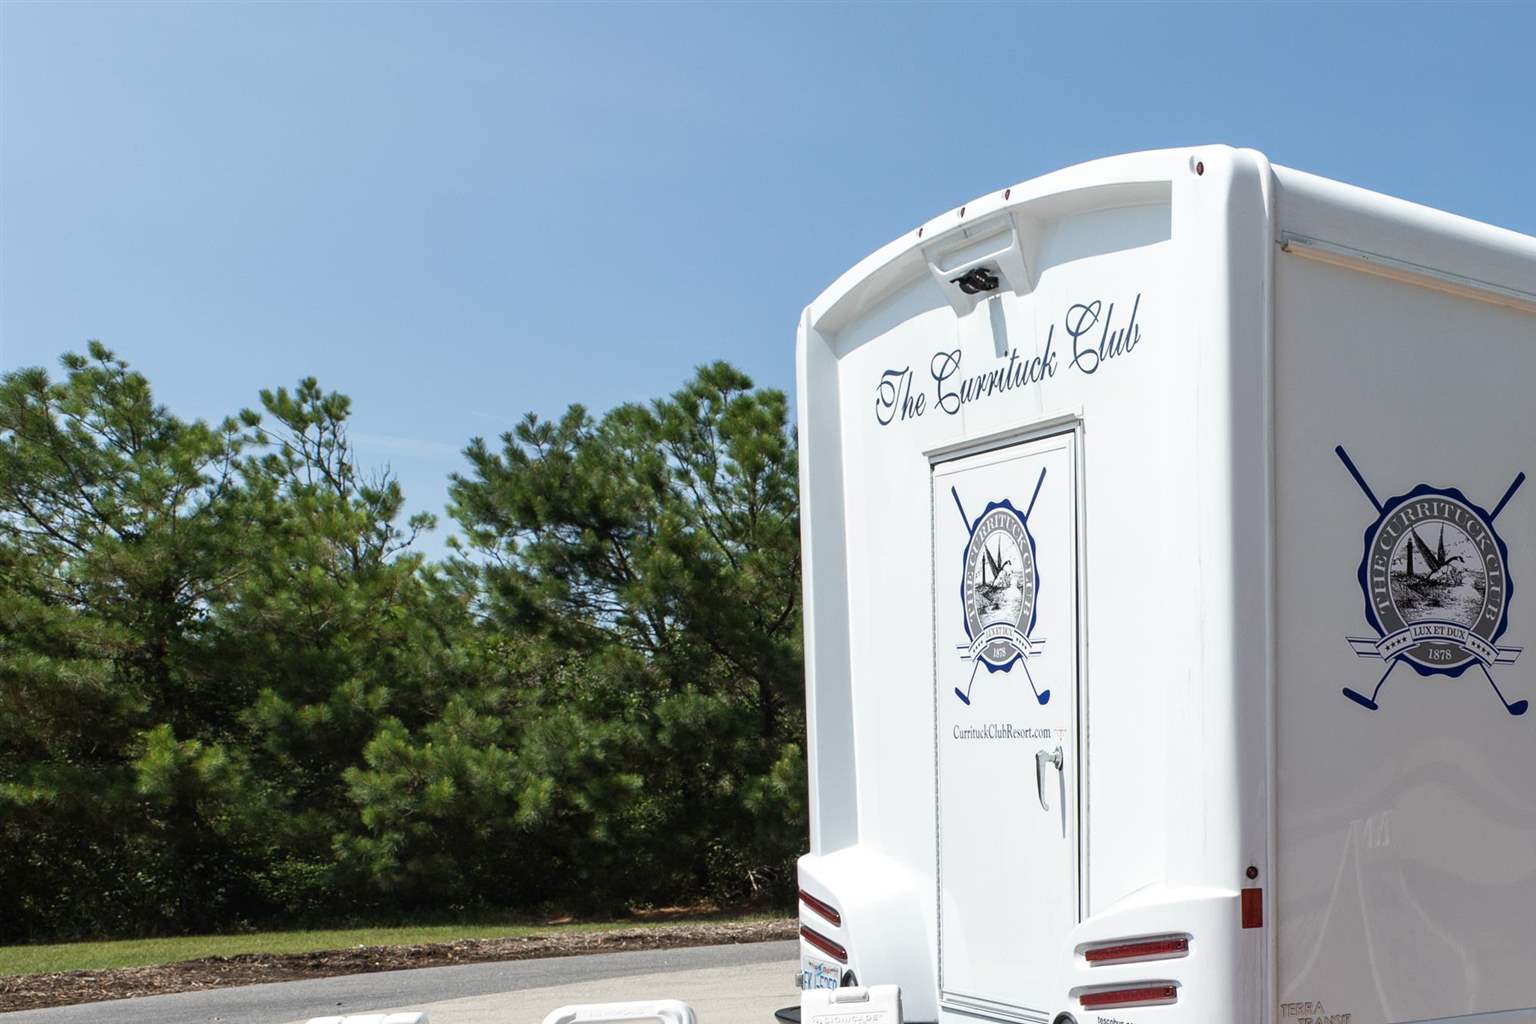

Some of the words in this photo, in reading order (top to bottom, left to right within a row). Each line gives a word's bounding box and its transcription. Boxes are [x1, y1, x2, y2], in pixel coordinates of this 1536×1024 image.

[876, 366, 927, 427] The
[931, 324, 1058, 416] Currituck
[1065, 293, 1143, 375] Club
[1380, 502, 1491, 549] CURRITUCK
[1374, 554, 1388, 615] THE
[1487, 552, 1501, 621] CLUB
[1413, 625, 1433, 638] LUX
[1434, 625, 1446, 636] ET
[1446, 625, 1466, 640] DUX
[1428, 648, 1452, 661] 1878
[953, 723, 1051, 740] CurrituckClubResort.com
